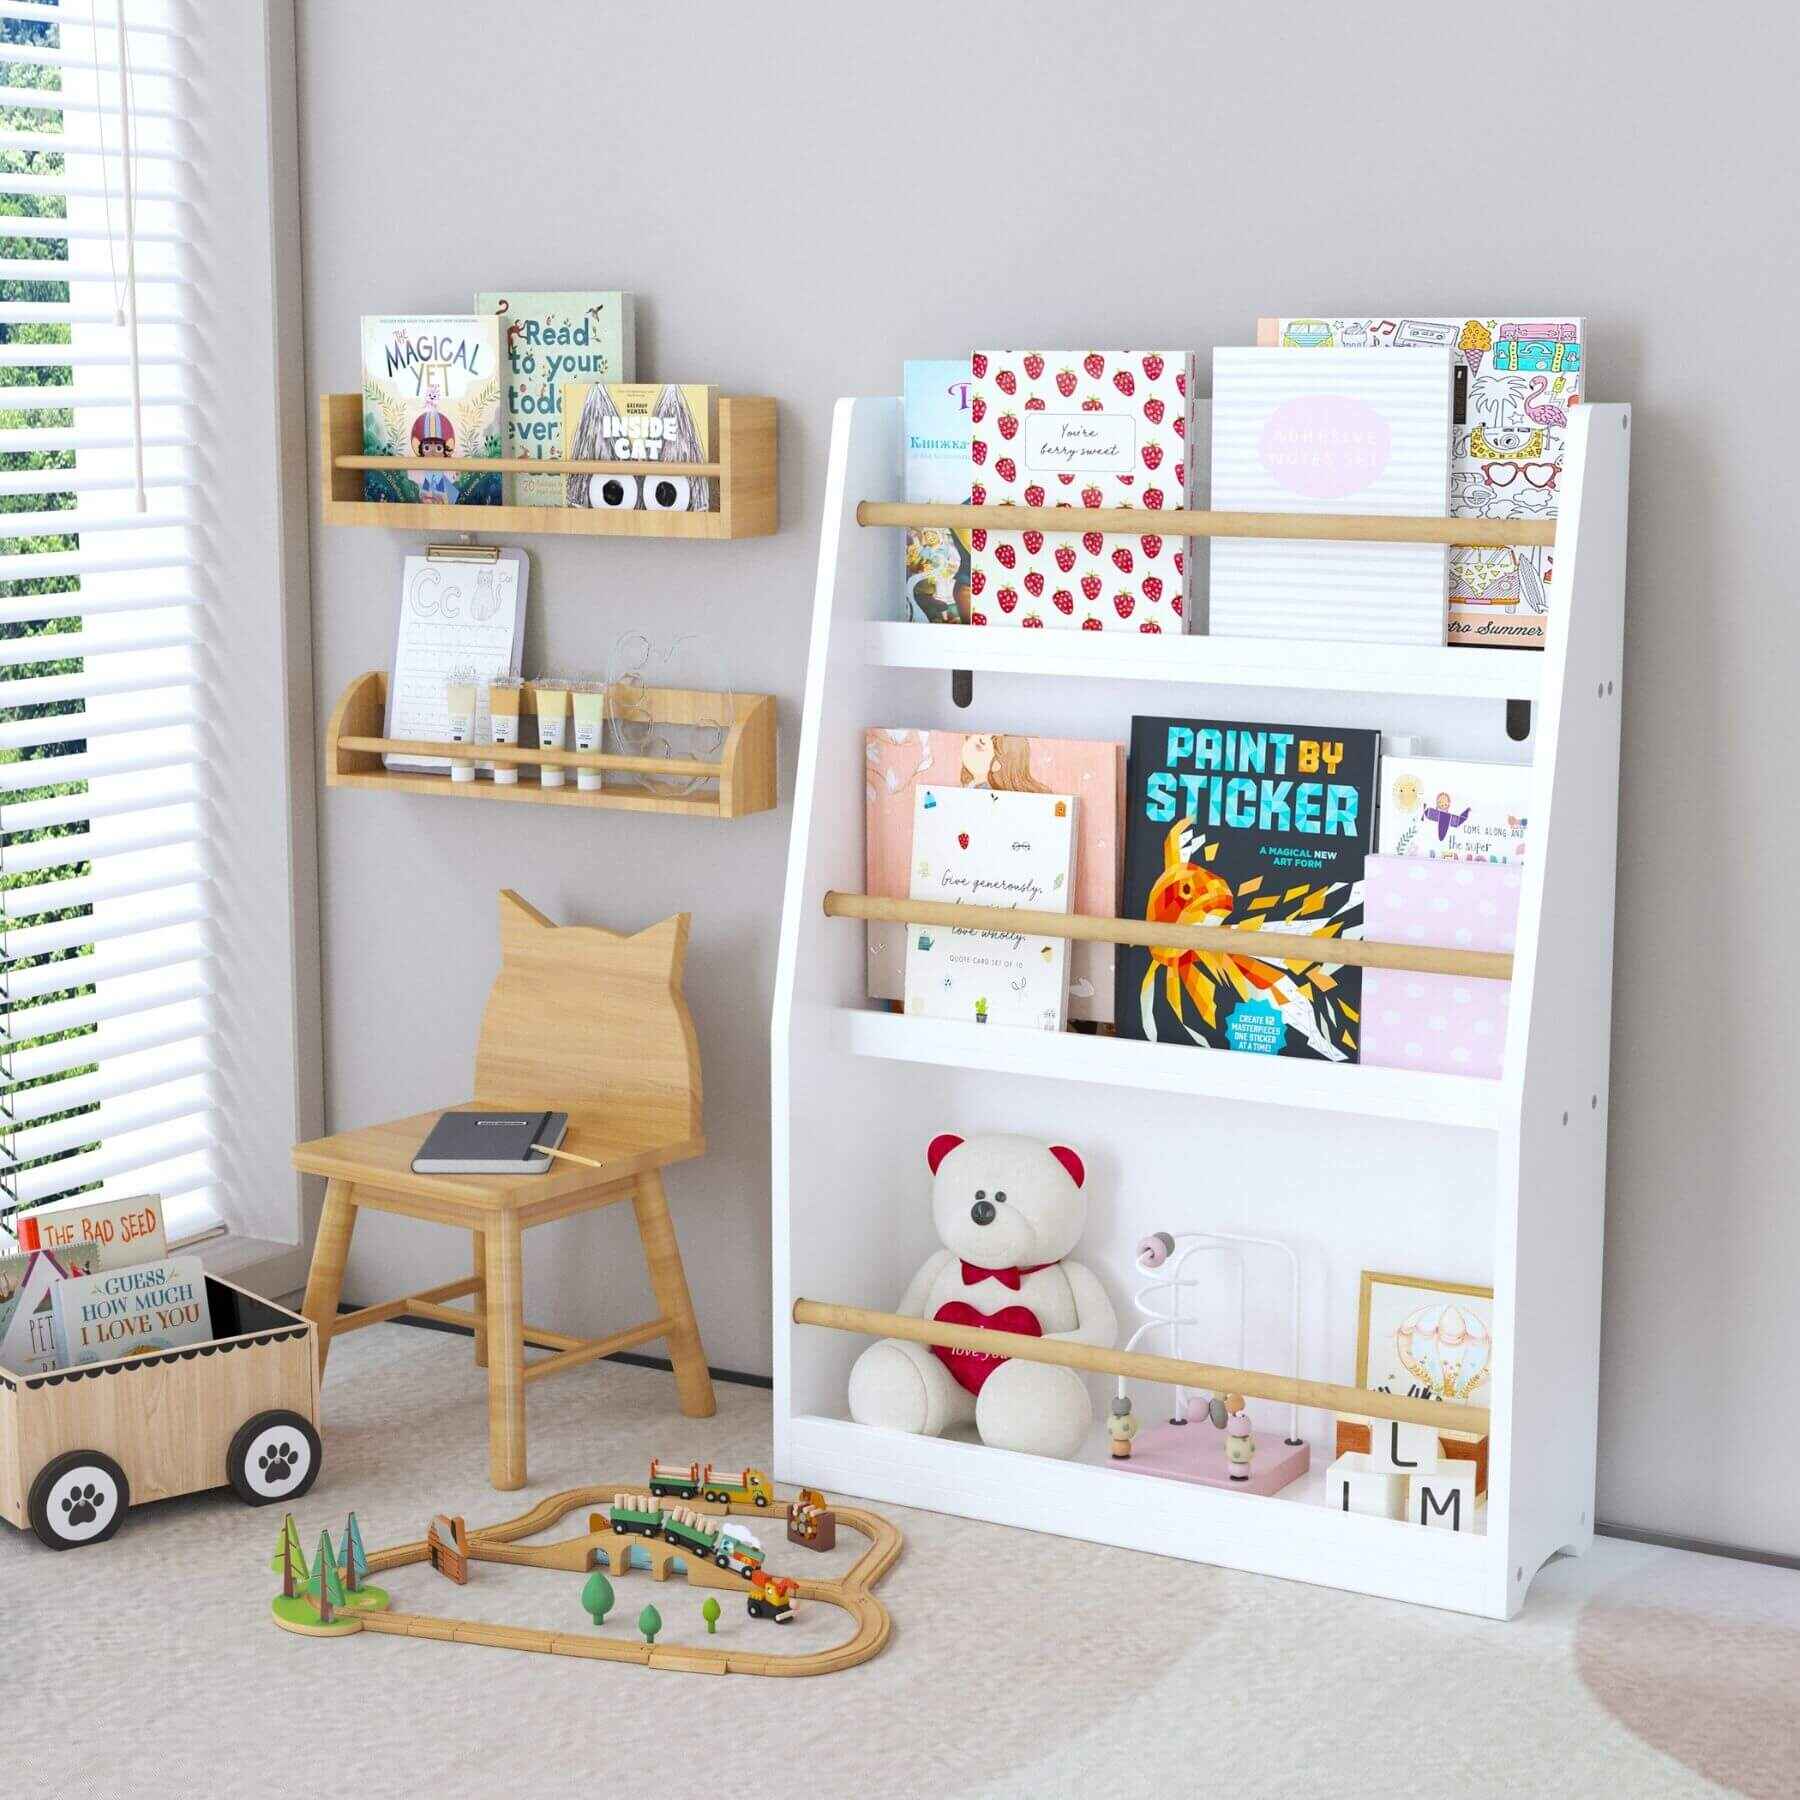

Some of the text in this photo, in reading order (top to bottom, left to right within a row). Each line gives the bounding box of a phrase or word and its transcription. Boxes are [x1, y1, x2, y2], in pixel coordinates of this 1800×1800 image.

[526, 317, 589, 346] Read
[384, 335, 480, 378] MAGICAL
[510, 348, 603, 382] to your
[410, 363, 453, 397] YET
[603, 415, 679, 441] INSIDE
[1061, 423, 1098, 439] You're
[614, 438, 663, 460] CAT
[1040, 442, 1119, 462] berry sweet
[1475, 620, 1544, 637] Summer
[1166, 726, 1344, 775] PAINT BY
[1146, 771, 1359, 837] STICKER
[1463, 825, 1481, 835] COME
[1260, 846, 1338, 860] A MAGICAL NEW
[1273, 856, 1322, 869] ART FORM
[941, 868, 969, 886] Give
[1231, 1023, 1281, 1036] MASTERPIECES
[1240, 1014, 1264, 1025] CREATE
[1234, 1032, 1277, 1045] ONE STICKER
[44, 1225, 74, 1246] THE
[120, 1208, 157, 1243] SEED
[105, 1268, 167, 1297] GUESS
[81, 1284, 195, 1322] HOW MUCH
[29, 1315, 55, 1354] PET
[81, 1303, 200, 1346] I LOVE YOU
[1391, 1421, 1418, 1468] L
[1420, 1486, 1461, 1532] M
